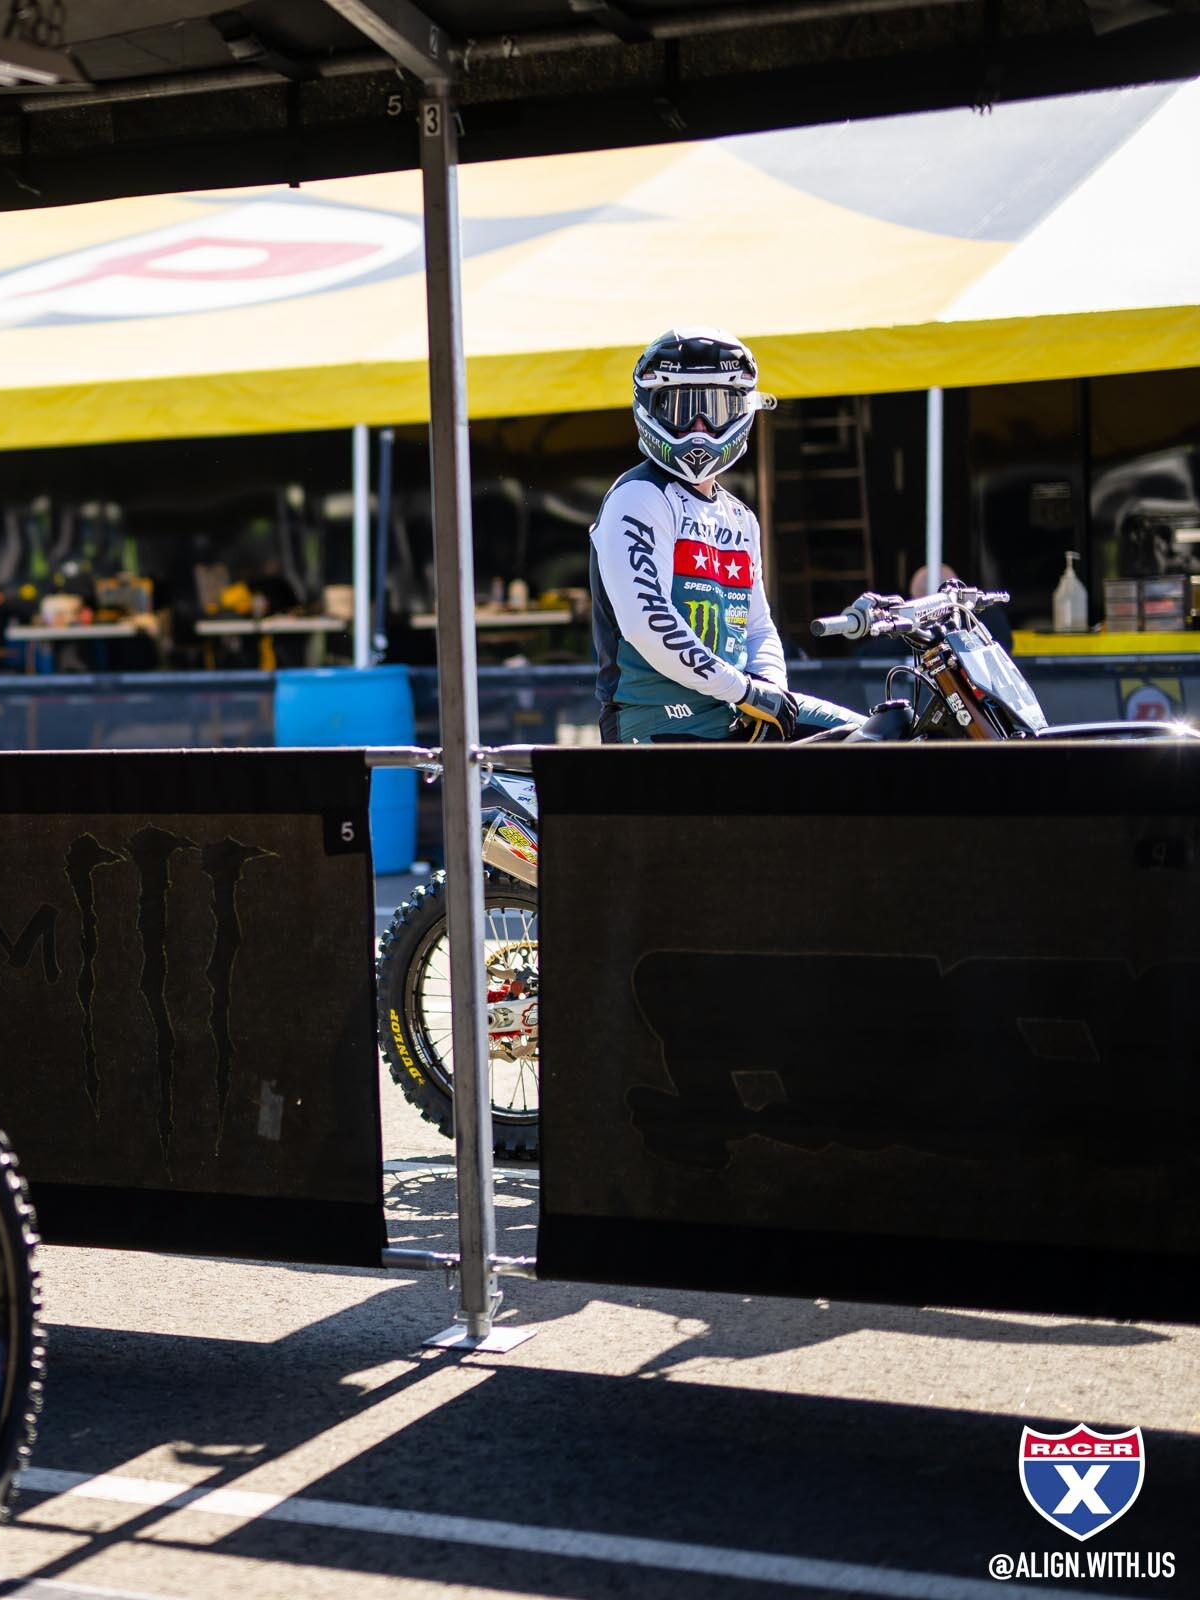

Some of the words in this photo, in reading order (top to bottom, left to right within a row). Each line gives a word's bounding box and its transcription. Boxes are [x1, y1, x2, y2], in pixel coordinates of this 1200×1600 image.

[386, 95, 402, 116] 5
[426, 107, 438, 133] 3
[621, 514, 717, 681] FASTHOUSE
[683, 581, 712, 592] SPEED
[727, 592, 746, 601] GOOD
[341, 820, 355, 842] 5
[389, 1008, 423, 1079] DUNLOP
